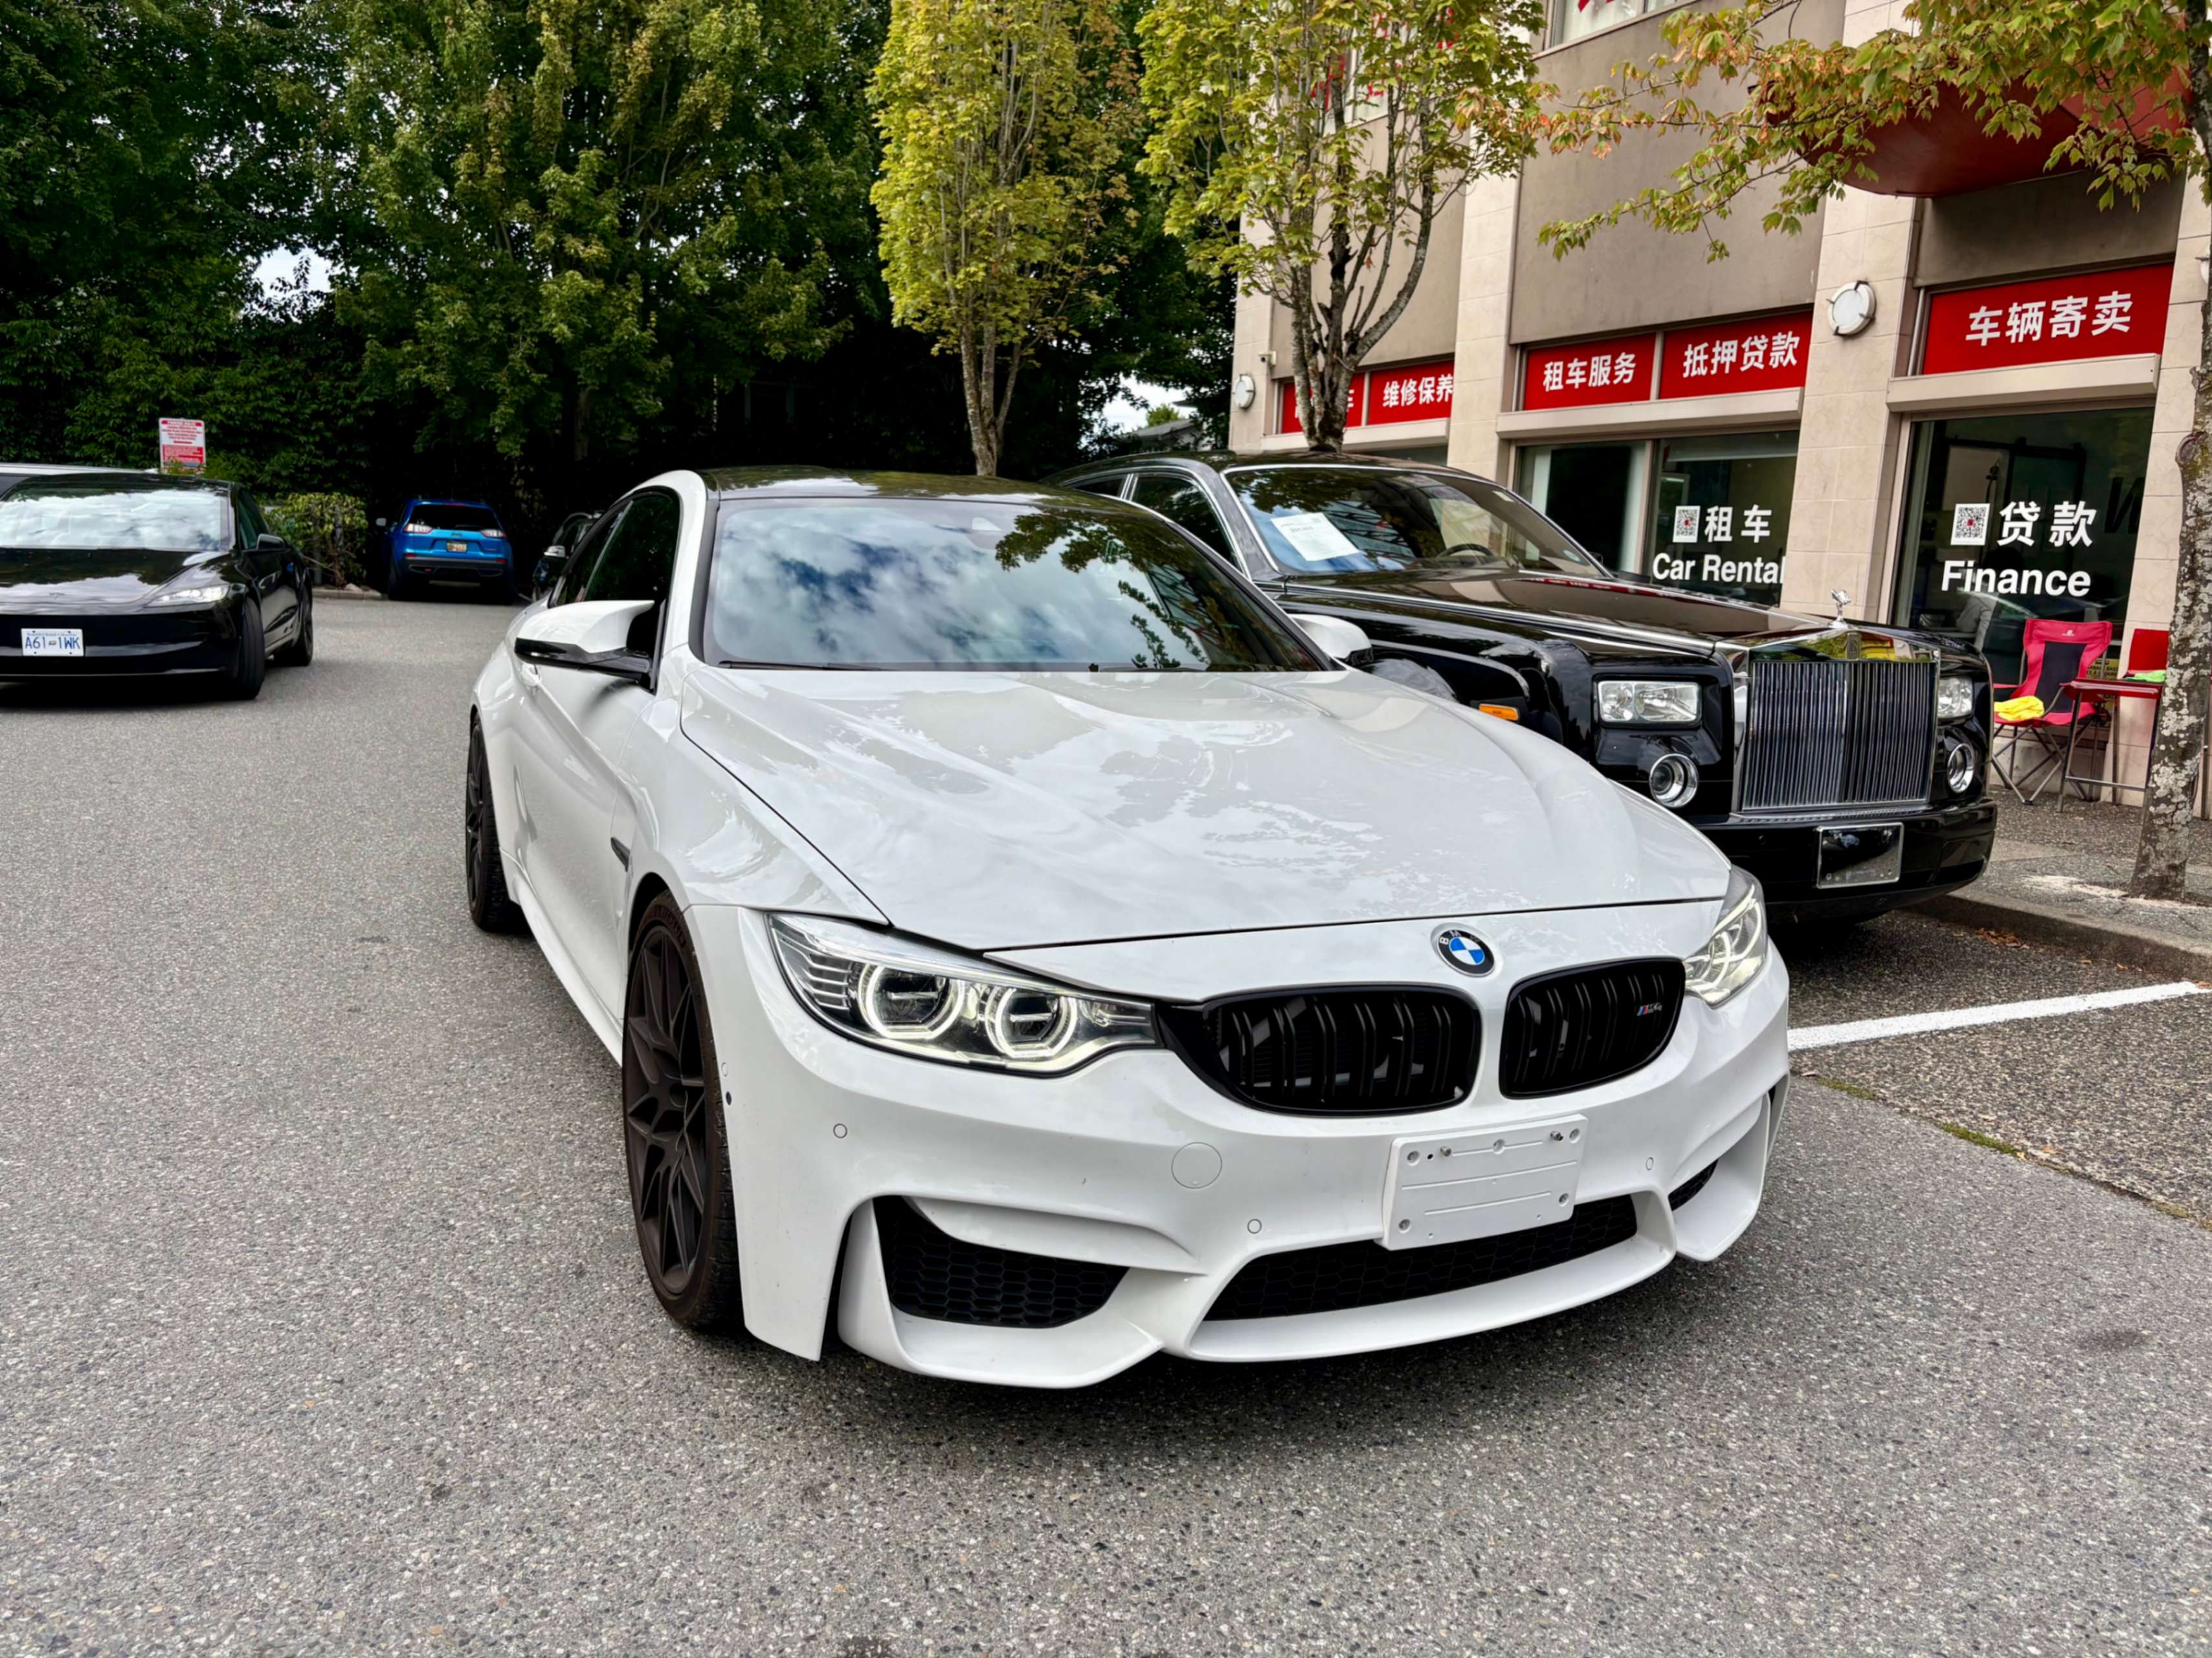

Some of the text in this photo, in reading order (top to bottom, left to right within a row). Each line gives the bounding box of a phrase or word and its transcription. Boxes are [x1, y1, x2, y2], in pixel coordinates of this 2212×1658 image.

[1965, 291, 2133, 346] 车辆寄卖
[1543, 352, 1637, 392] 租车服务
[1682, 331, 1800, 378] 抵押贷款
[1382, 373, 1454, 408] 维修保养
[1704, 504, 1772, 543] 租车
[1996, 500, 2097, 547] 贷款
[1653, 552, 1786, 584] Car Rental
[1941, 559, 2092, 597] Finance
